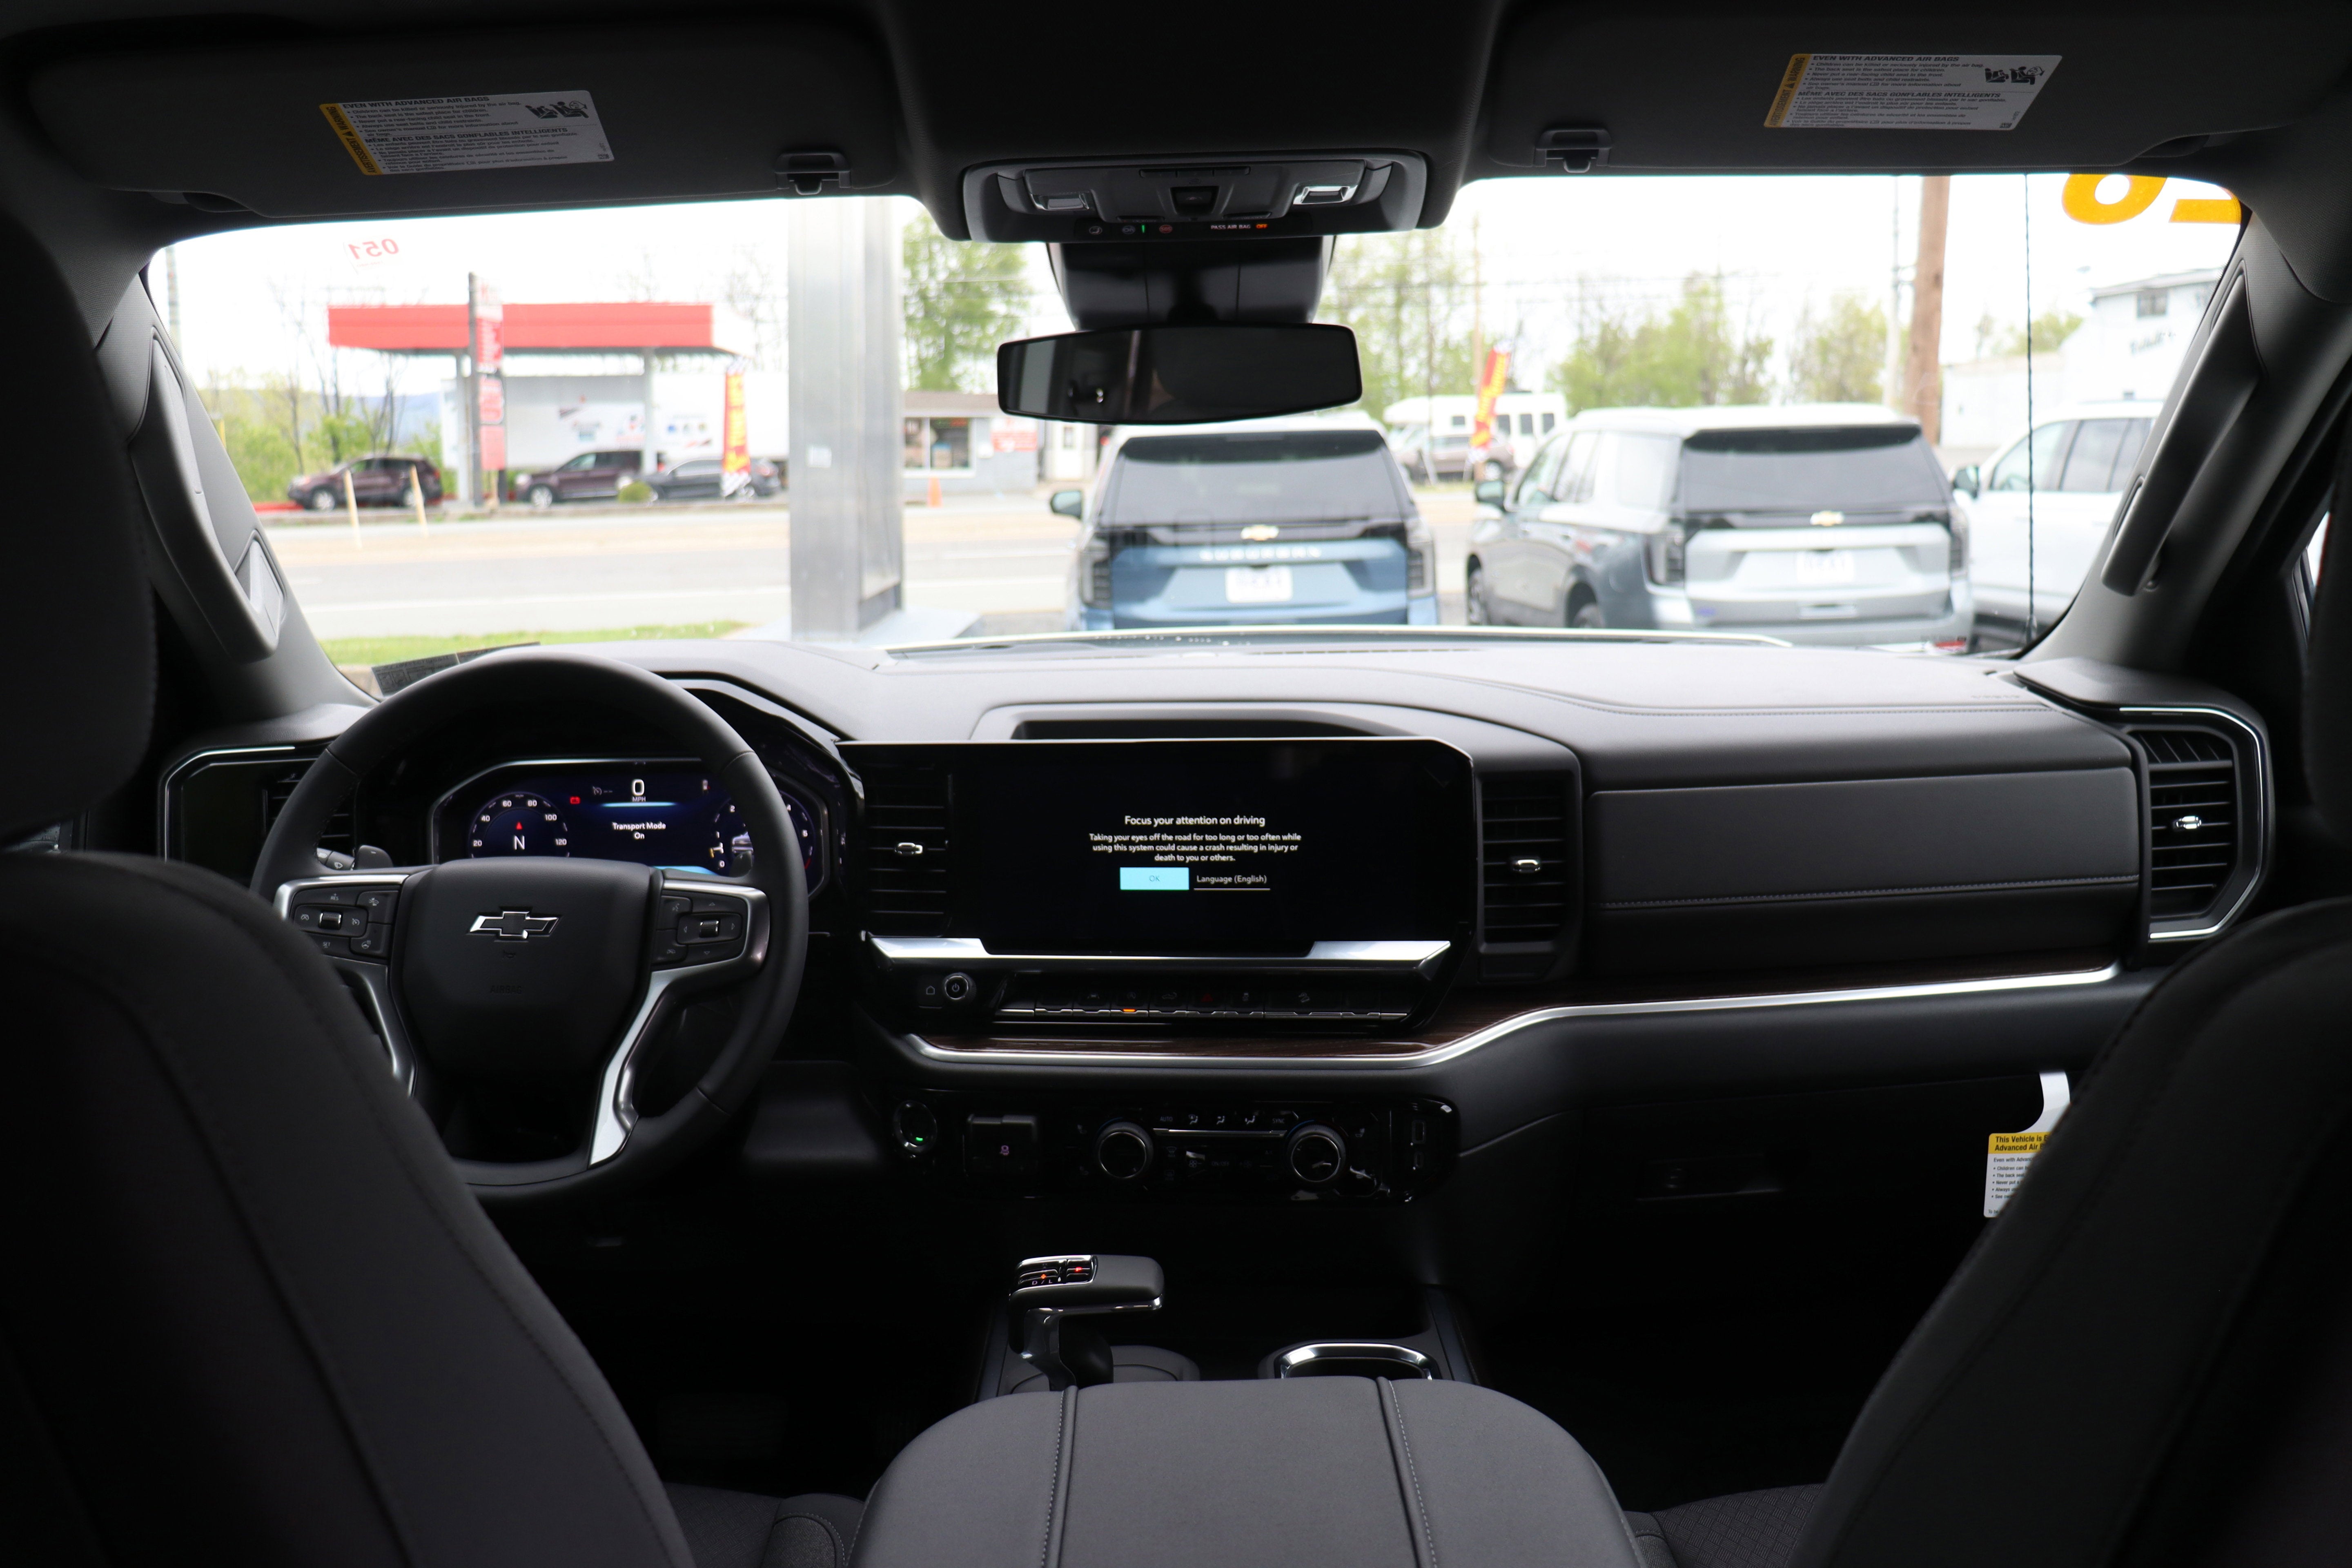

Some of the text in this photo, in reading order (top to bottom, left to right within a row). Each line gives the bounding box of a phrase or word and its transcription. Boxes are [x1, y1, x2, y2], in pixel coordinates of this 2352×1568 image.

[1787, 57, 1805, 82] WARNING
[326, 107, 350, 131] WARNING
[632, 779, 644, 796] 0
[612, 821, 666, 831] Transport Mode
[1125, 815, 1152, 825] Focus
[1154, 817, 1174, 827] your
[1176, 815, 1218, 825] attention
[1233, 815, 1265, 827] driving
[514, 835, 525, 850] N
[1089, 833, 1113, 843] Taking
[1219, 833, 1236, 843] long
[1260, 833, 1281, 841] often
[1093, 844, 1113, 853] using
[1129, 844, 1154, 853] system
[1226, 843, 1258, 853] resulting
[1268, 844, 1289, 853] injury
[1196, 875, 1267, 884] Language (English)
